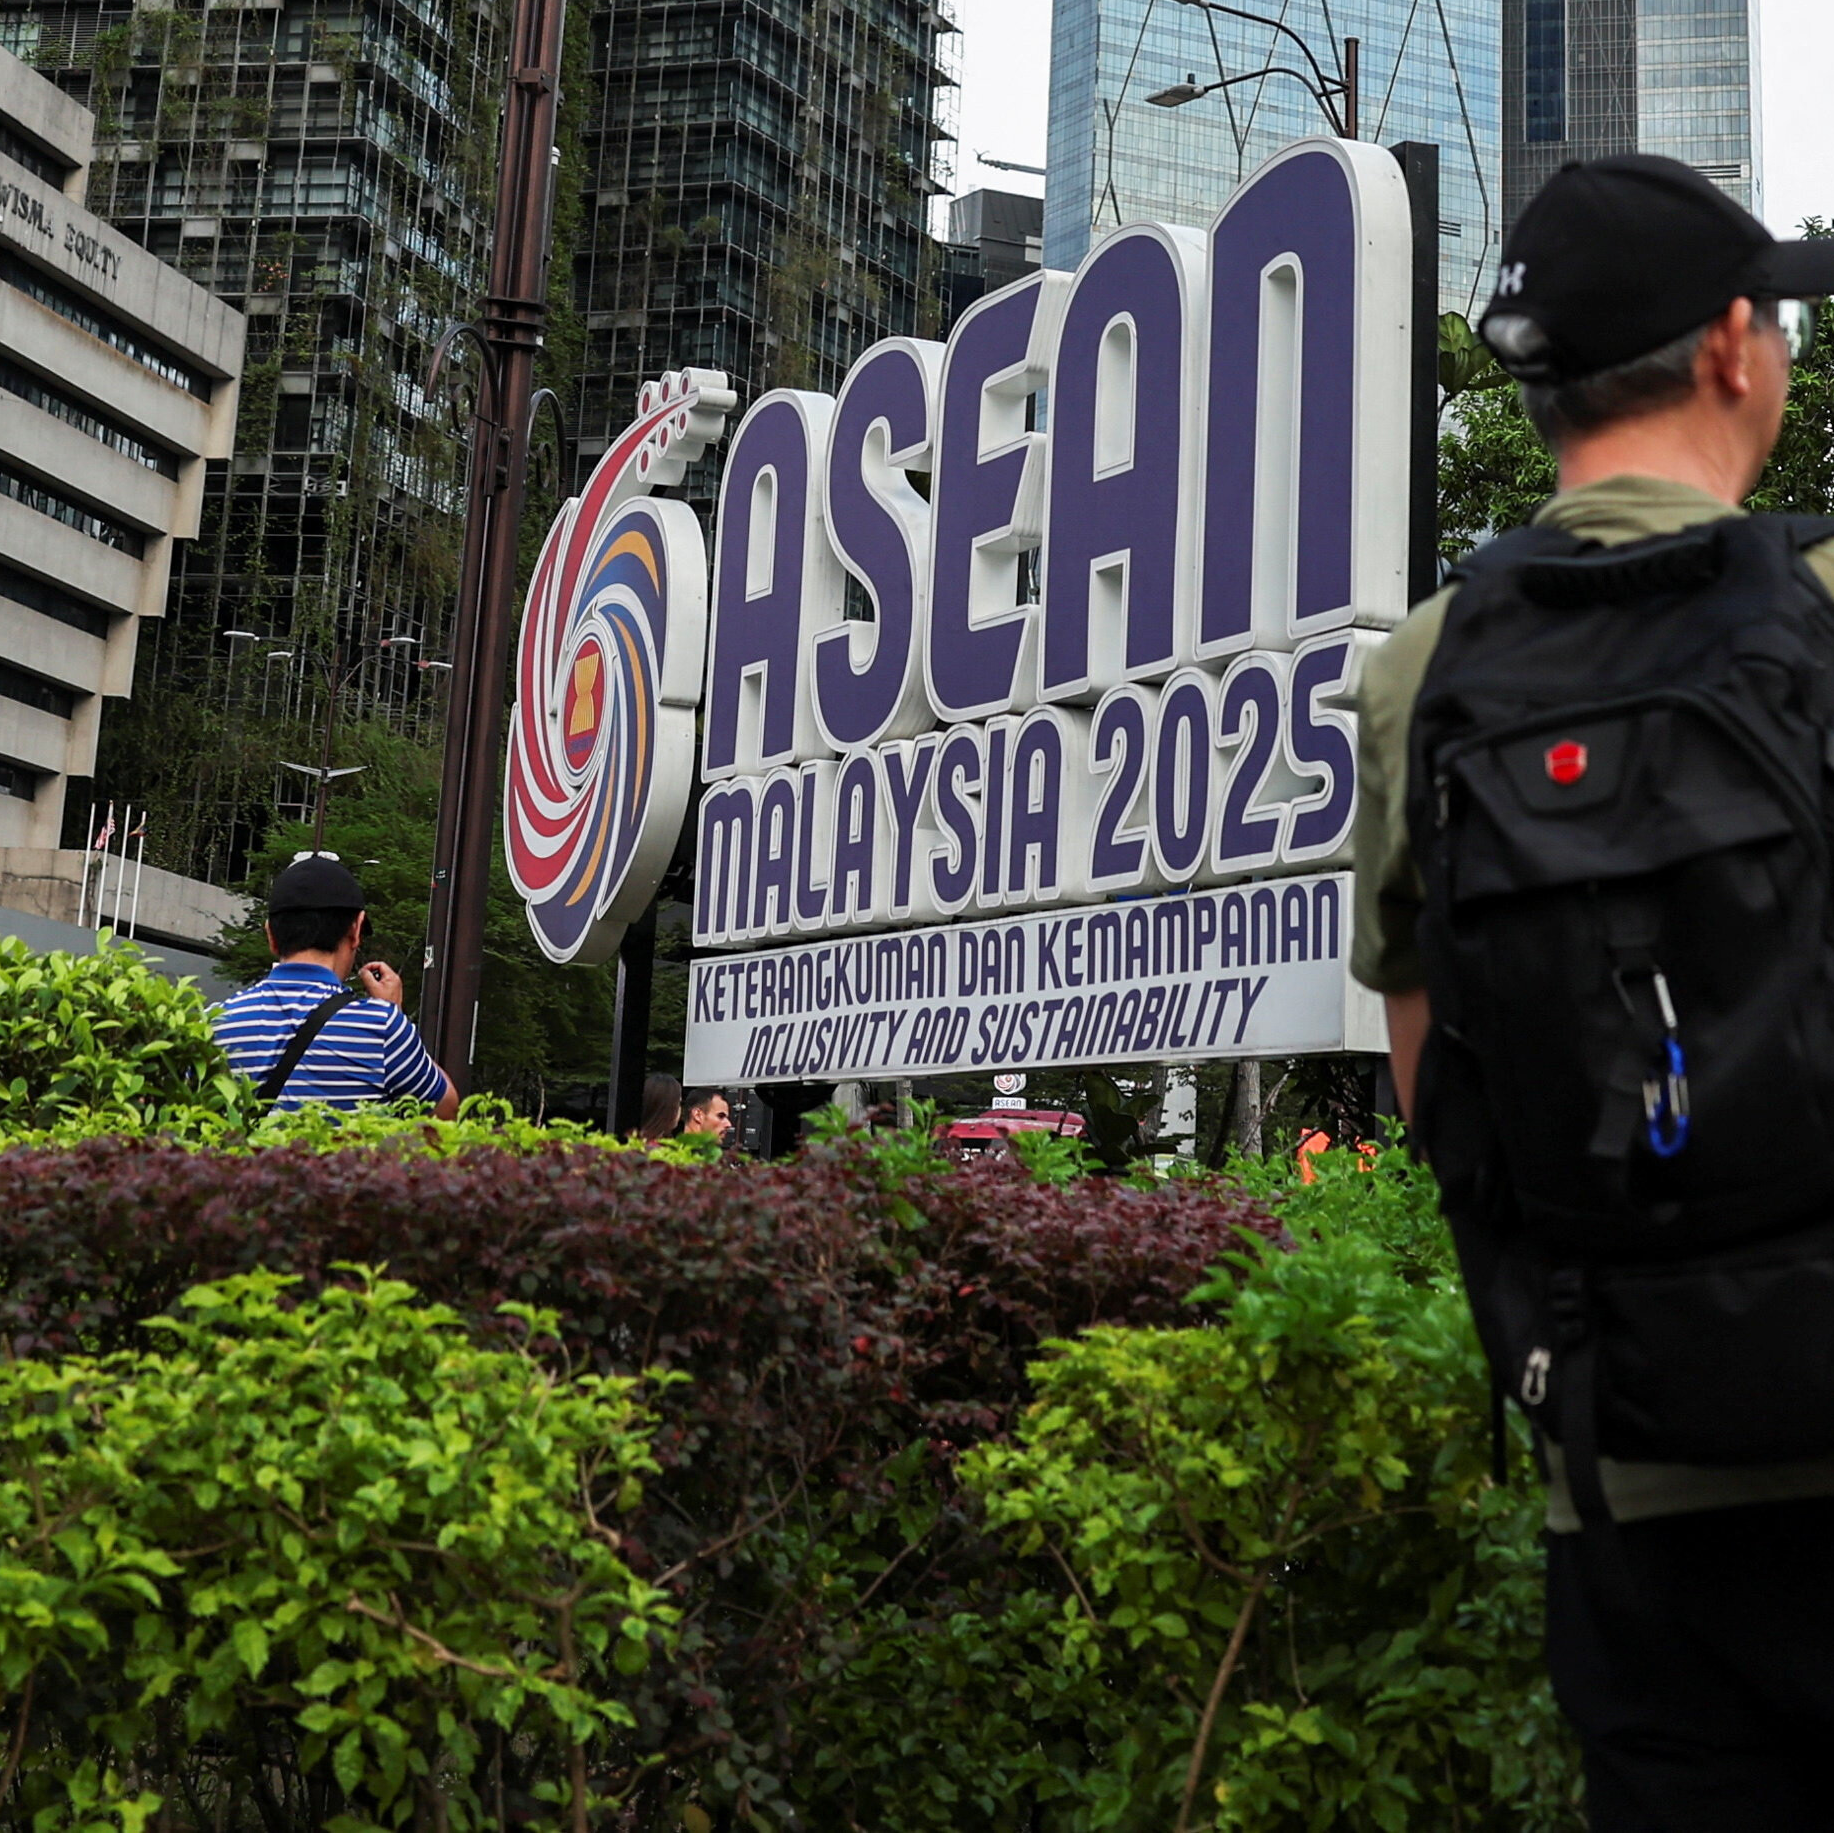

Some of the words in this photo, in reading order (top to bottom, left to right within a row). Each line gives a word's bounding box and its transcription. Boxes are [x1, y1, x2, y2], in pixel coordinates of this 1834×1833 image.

[63, 222, 124, 281] EQUITY
[708, 151, 1355, 769] ASEAN
[698, 720, 1062, 935] MALAYSIA
[1093, 644, 1355, 878] 2025
[694, 932, 947, 1023] KETERANGKUMAN
[958, 926, 1026, 997] DAN
[1038, 879, 1339, 991] KEMAMPANAN
[740, 1009, 908, 1078] INCLUSIVITY
[904, 1006, 971, 1065] AND
[970, 976, 1269, 1065] SUSTAINABILITY
[994, 1098, 1022, 1108] ASEAN
